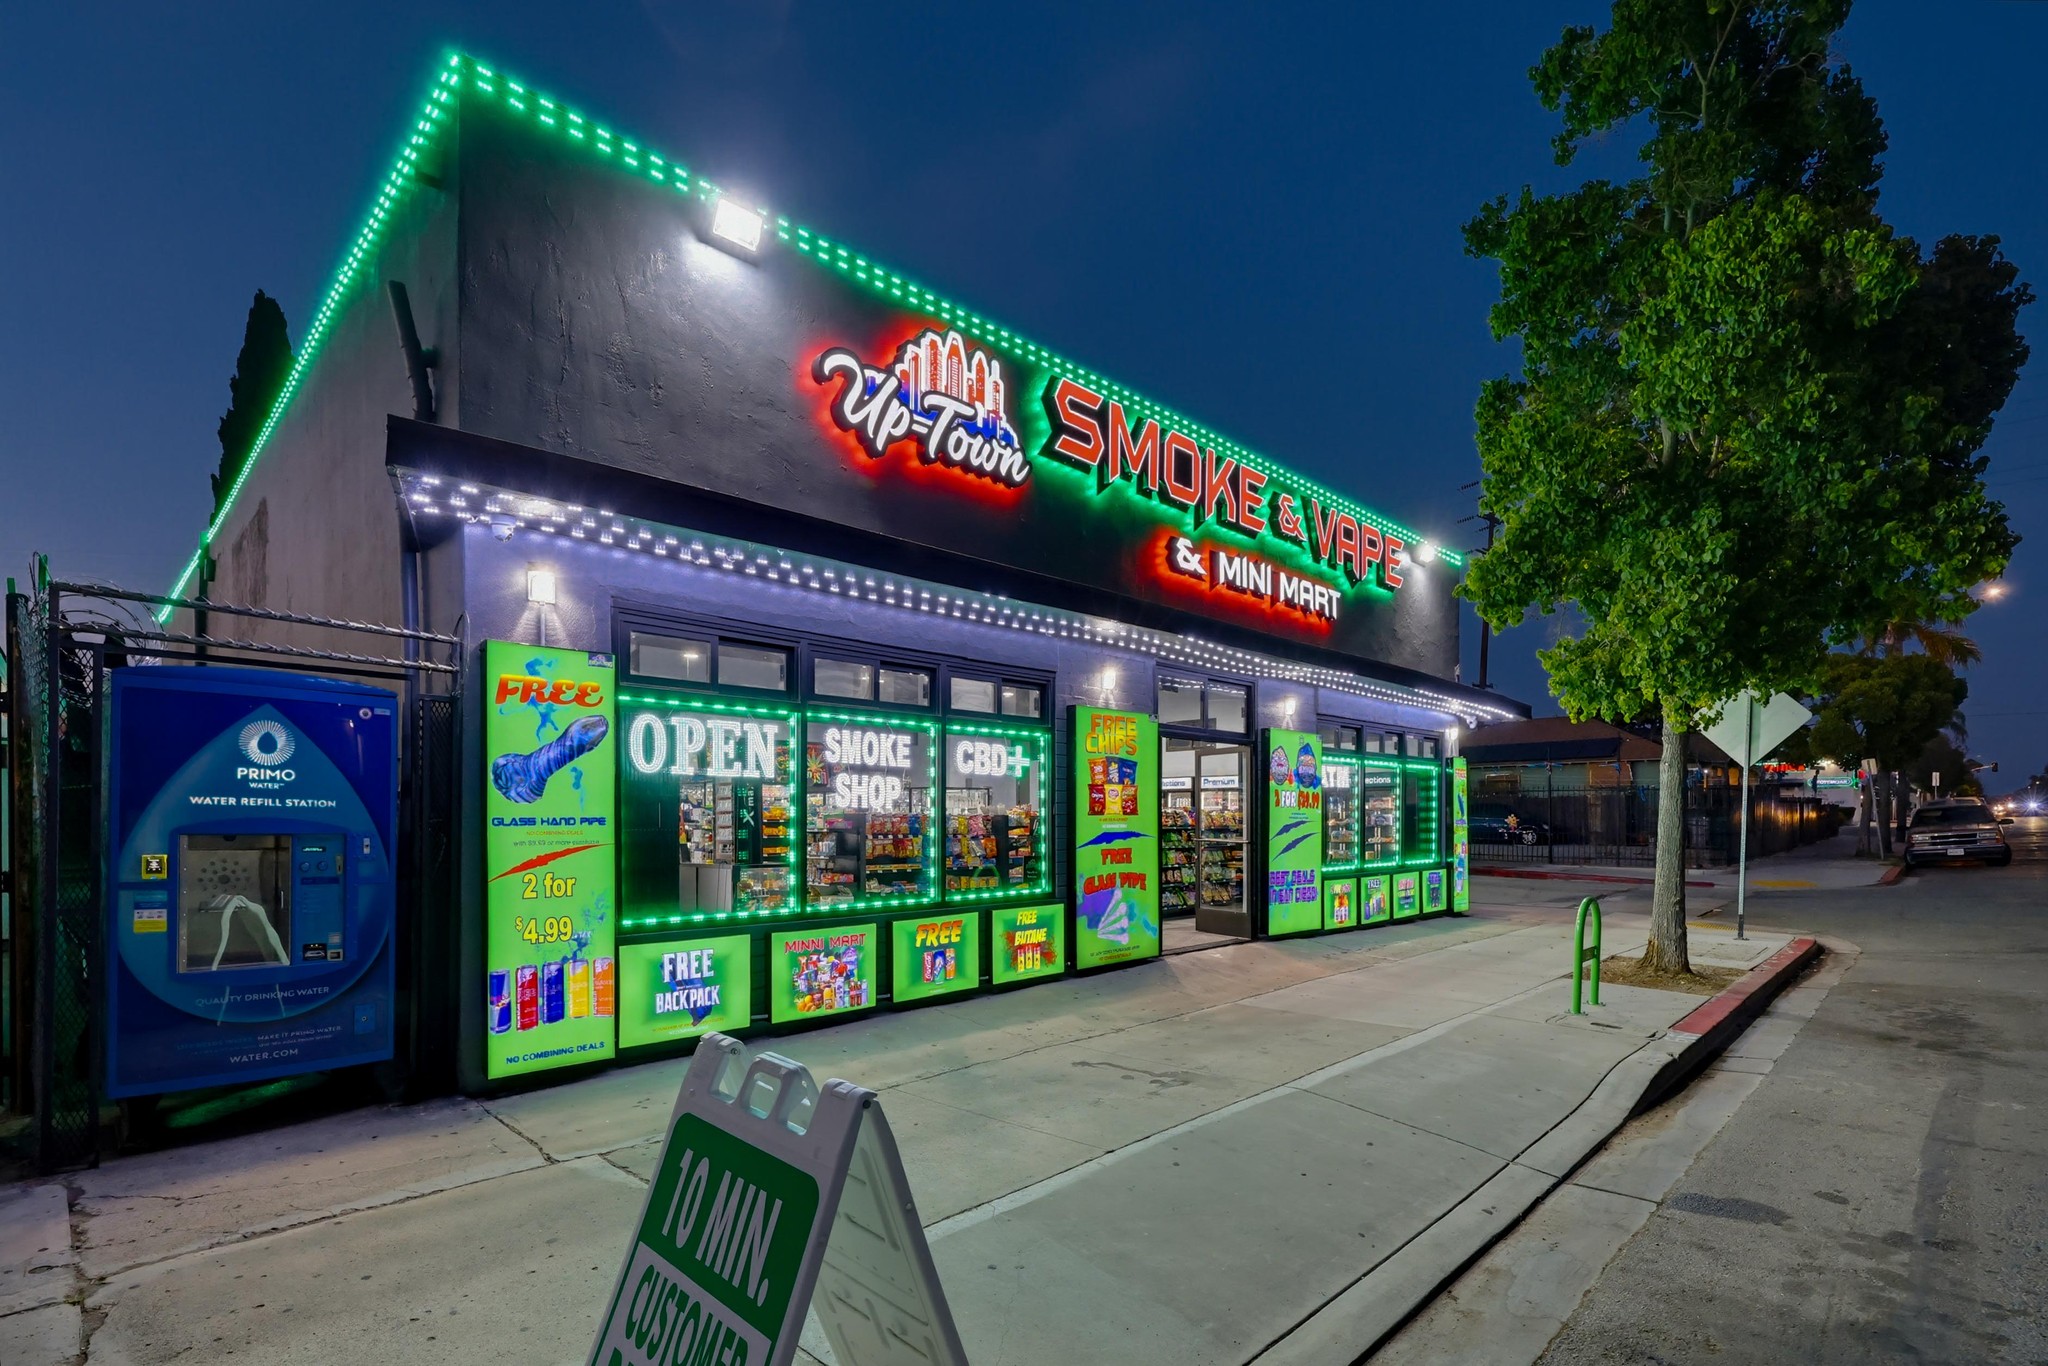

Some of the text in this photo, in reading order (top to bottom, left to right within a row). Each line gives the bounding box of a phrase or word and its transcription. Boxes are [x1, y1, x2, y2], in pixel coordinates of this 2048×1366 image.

[824, 353, 1030, 482] Up-Town
[1055, 378, 1404, 589] SMOKE & VAPE
[1175, 537, 1342, 620] & MINI MART
[495, 674, 604, 707] FREE
[1091, 713, 1137, 738] FREE
[630, 713, 778, 778] OPEN
[824, 727, 911, 768] SMOKE
[1085, 732, 1138, 756] CHIPS
[237, 767, 296, 781] PRIMO
[1203, 778, 1236, 786] Premium
[189, 796, 337, 808] WATER REFILL STATION
[835, 772, 901, 809] SHOP
[492, 817, 607, 827] GLASS HAND PIPE
[1101, 847, 1132, 866] FREE
[522, 871, 576, 900] 2 for
[1083, 872, 1117, 895] GLASS
[514, 916, 573, 944] $4.99
[1016, 910, 1037, 926] FREE
[784, 933, 867, 954] MINNI MART
[915, 920, 963, 948] FREE
[662, 948, 715, 983] FREE
[297, 986, 330, 996] WATER
[229, 1048, 299, 1063] WATER.COM
[506, 1041, 605, 1065] NO COMBINING DEALS
[661, 1148, 782, 1307] 10 MIN.
